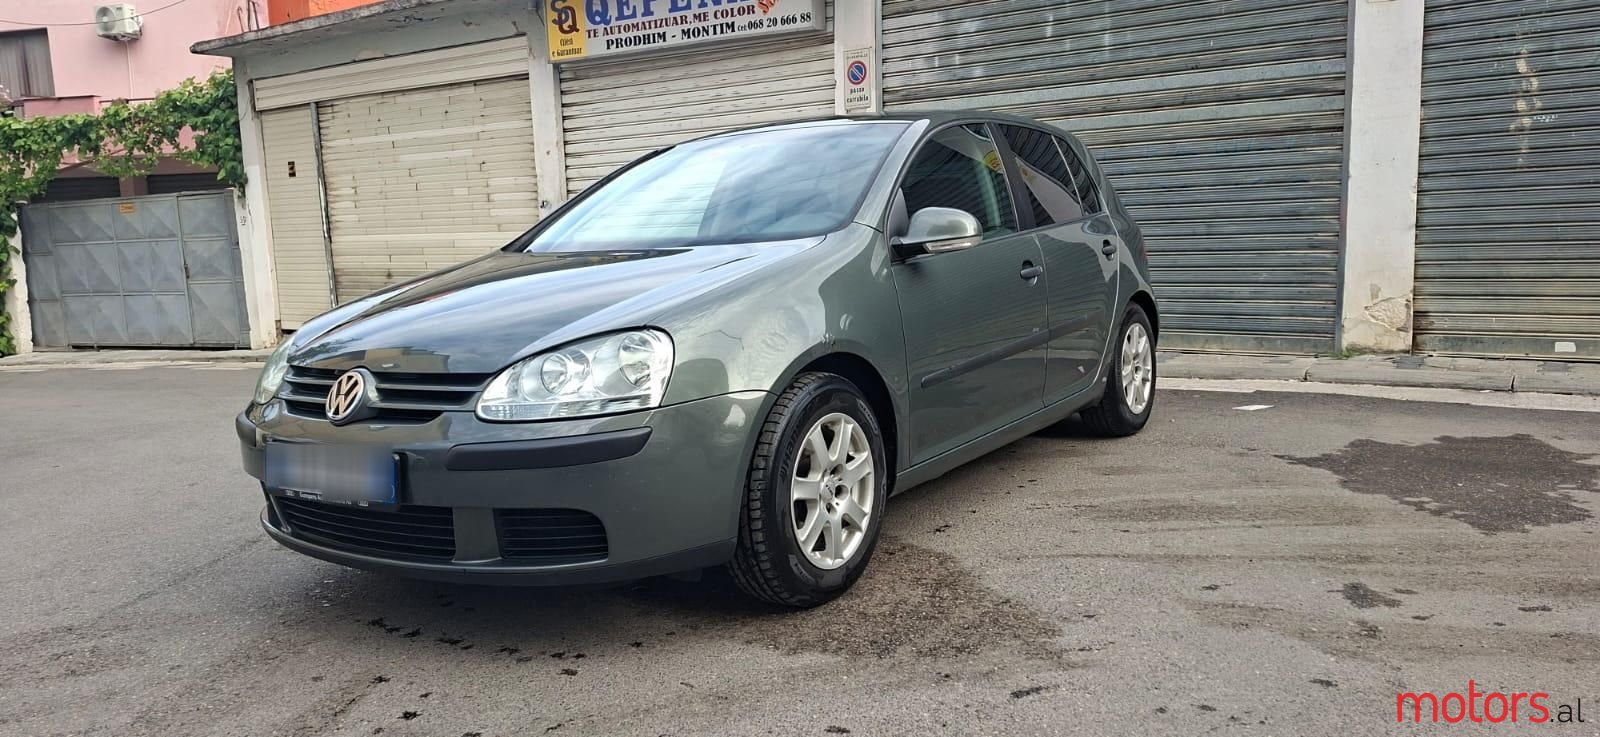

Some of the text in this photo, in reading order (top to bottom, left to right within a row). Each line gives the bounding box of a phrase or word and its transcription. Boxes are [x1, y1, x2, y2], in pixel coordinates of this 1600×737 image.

[586, 28, 600, 39] TE
[713, 4, 756, 20] COLOR
[606, 31, 667, 50] PRODHIM
[681, 21, 736, 40] MONTIM
[766, 16, 778, 28] 20
[780, 14, 798, 26] 666
[799, 12, 812, 23] 88
